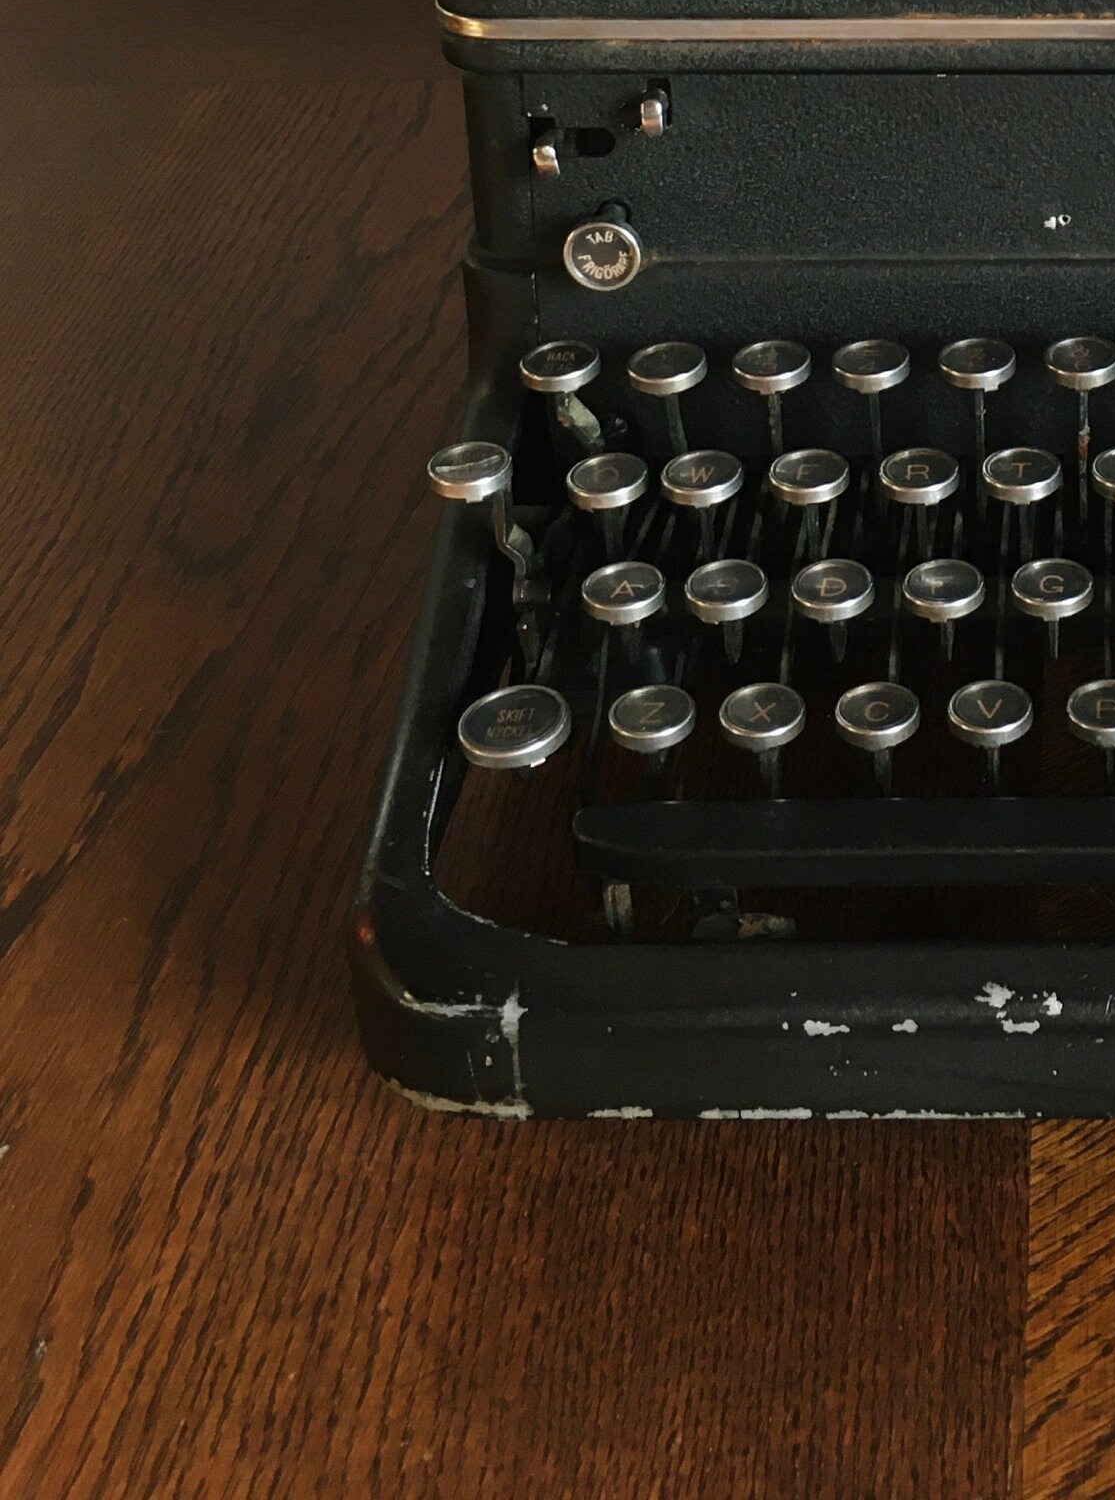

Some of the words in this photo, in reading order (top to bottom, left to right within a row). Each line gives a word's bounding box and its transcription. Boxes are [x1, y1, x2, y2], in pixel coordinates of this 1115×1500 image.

[585, 230, 613, 244] TAB
[690, 465, 716, 484] W
[905, 464, 929, 481] R
[1011, 462, 1032, 479] T
[610, 579, 636, 599] A
[819, 577, 847, 597] D
[1038, 575, 1065, 594] G
[497, 707, 536, 724] SKIFT
[638, 701, 666, 725] Z
[749, 701, 777, 723] X
[863, 701, 891, 722] C
[976, 698, 1003, 720] V
